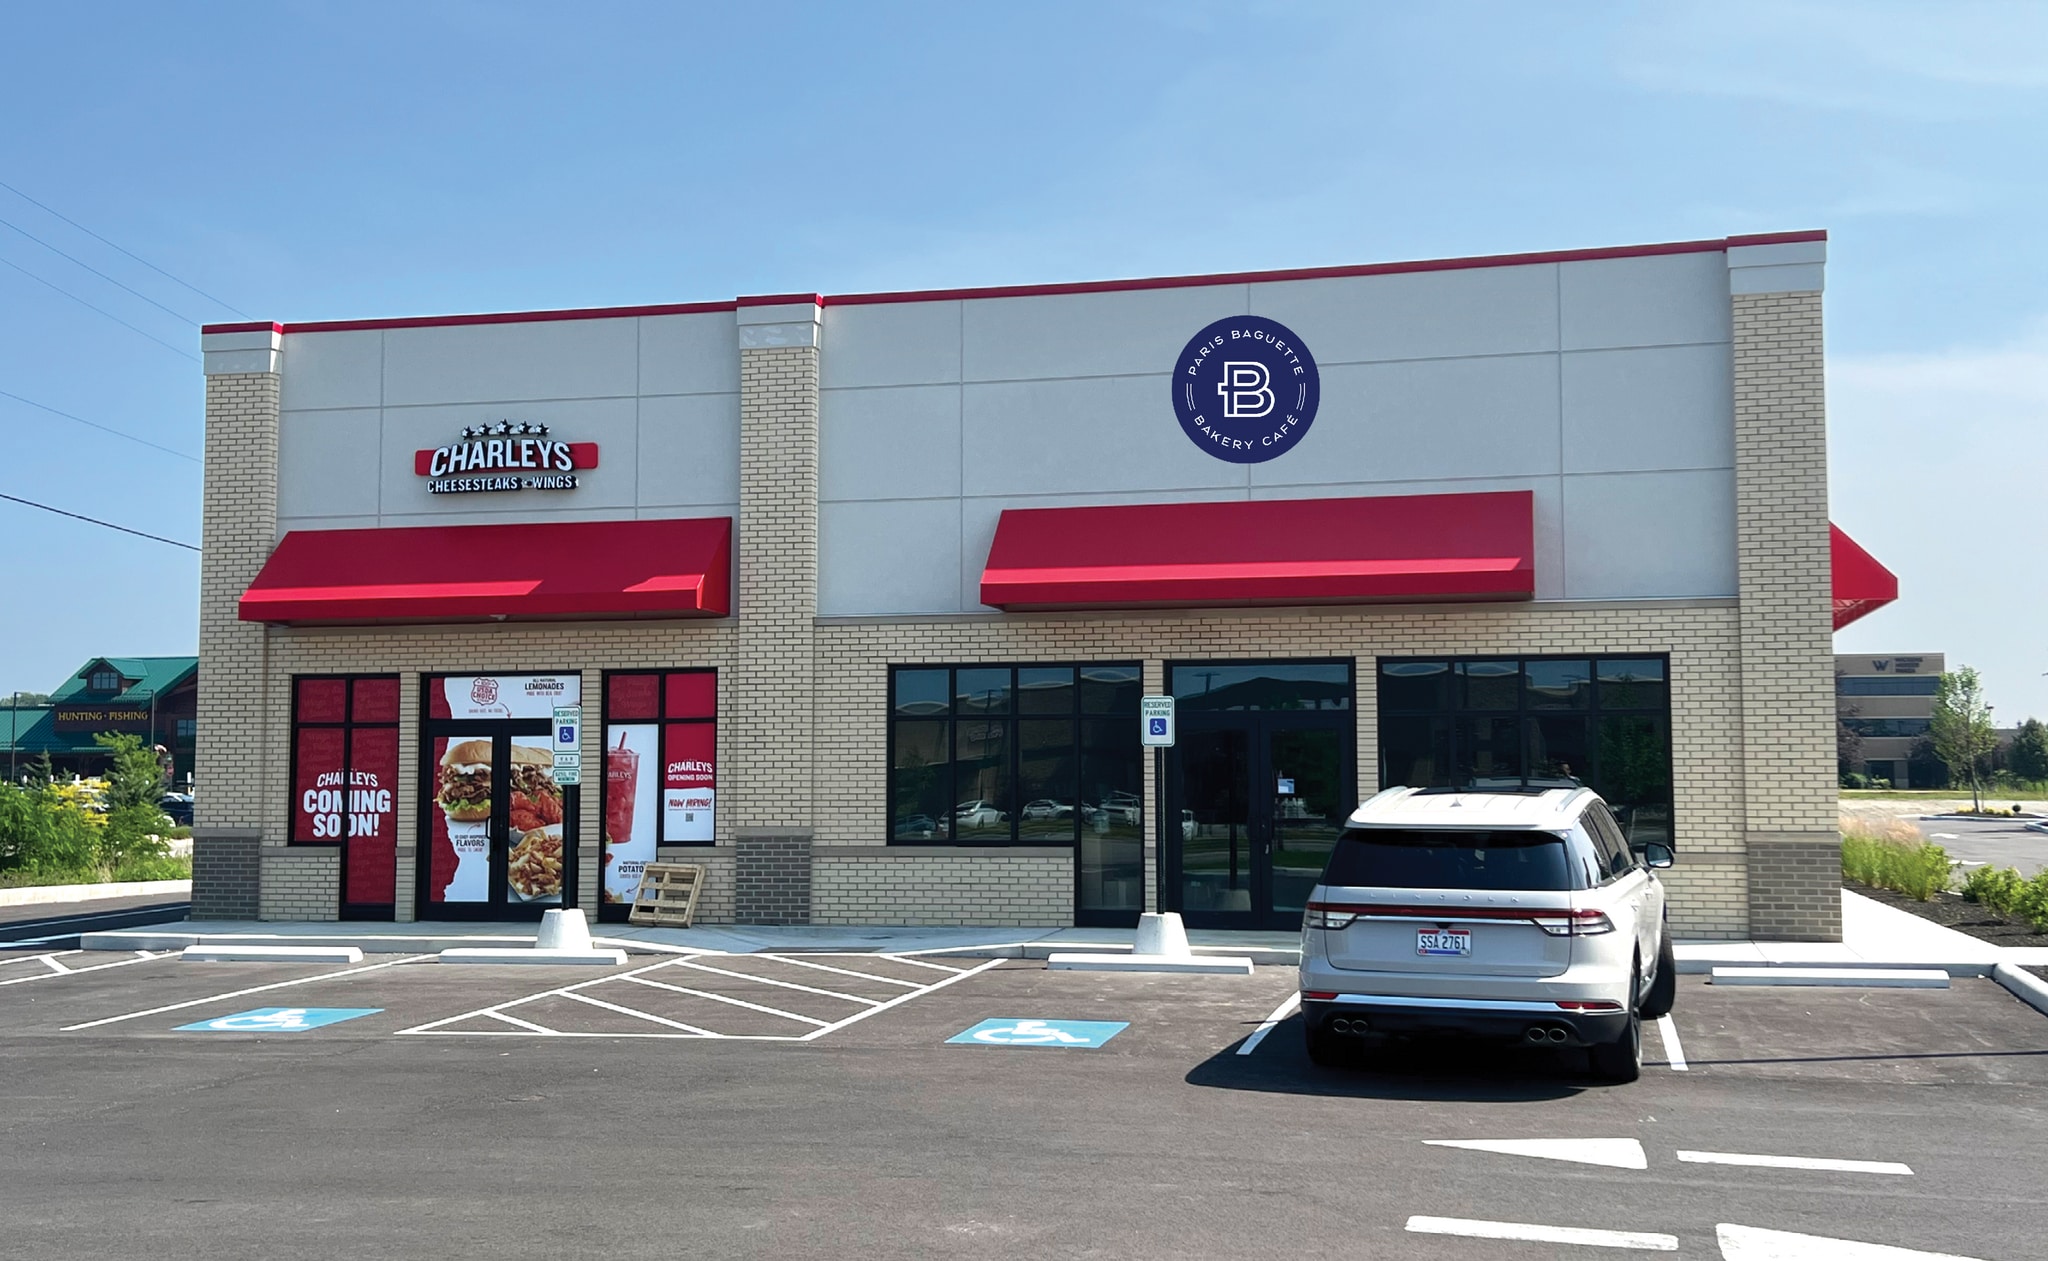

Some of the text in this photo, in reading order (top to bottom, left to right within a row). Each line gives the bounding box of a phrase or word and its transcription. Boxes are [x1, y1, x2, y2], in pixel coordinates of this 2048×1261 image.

[1188, 329, 1304, 376] PARIS BAGUETTE
[1194, 413, 1299, 450] BAKERY CAFÉ
[429, 438, 574, 477] CHARLEYS
[427, 475, 573, 493] CHEESESTEAKS WINGS
[524, 682, 564, 690] LEMONADES
[473, 692, 495, 700] CHOICE
[58, 711, 148, 721] HUNTING FISHING
[667, 761, 713, 773] CHARLEYS
[668, 798, 712, 808] NOW HIRING!
[1369, 892, 1520, 904] LINCOLN
[1420, 935, 1466, 950] SSA 2761
